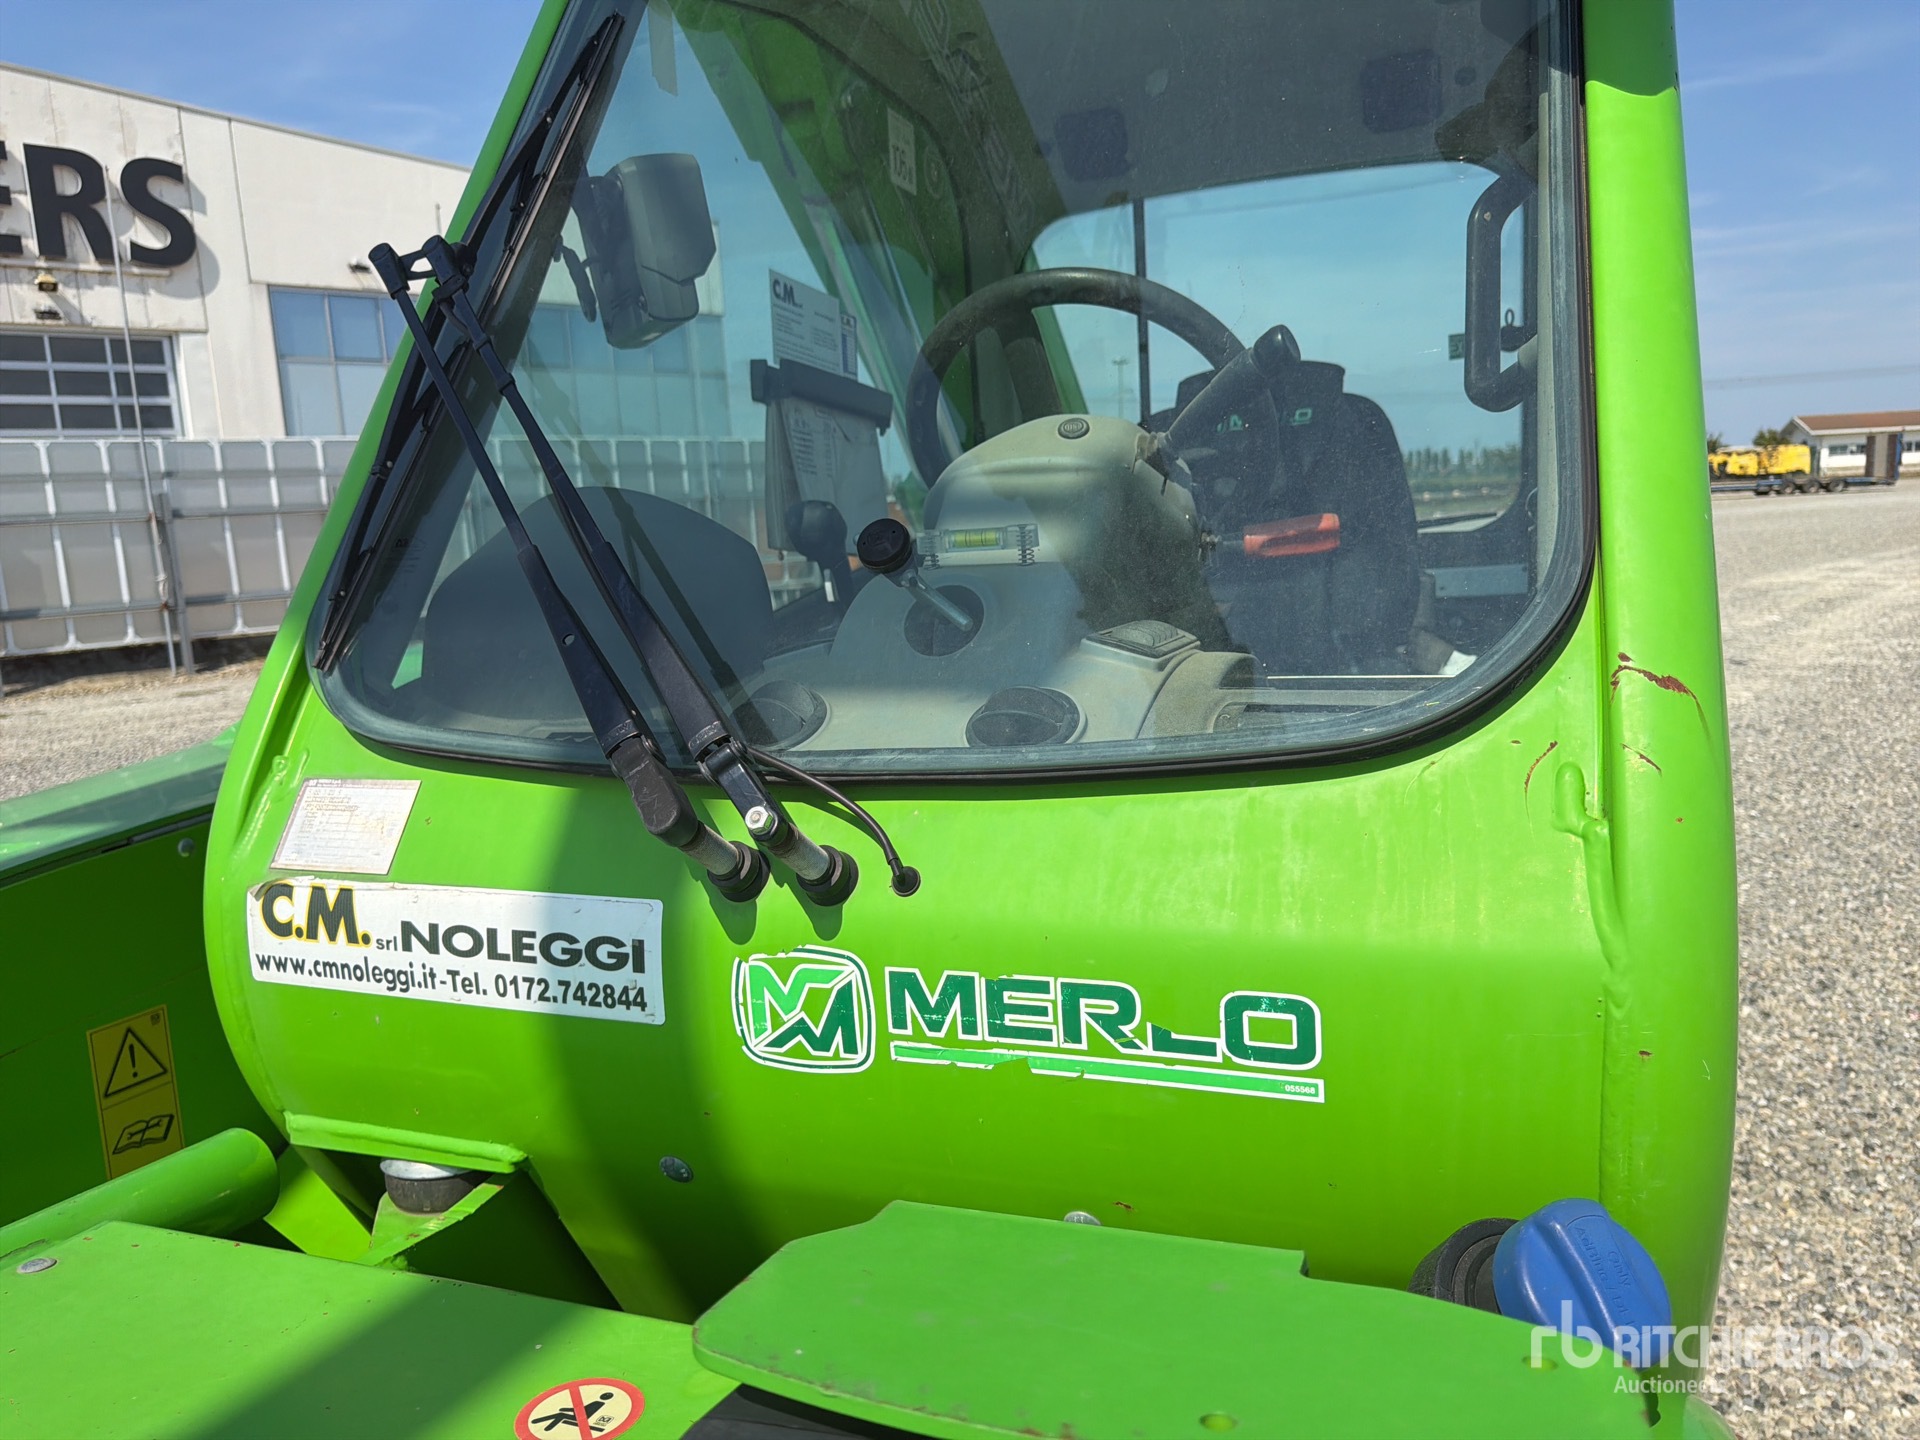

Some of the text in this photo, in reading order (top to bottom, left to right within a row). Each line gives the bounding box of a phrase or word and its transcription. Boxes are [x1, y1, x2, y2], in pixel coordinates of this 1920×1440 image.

[262, 880, 646, 974] C.M. srl NOLEGGI
[494, 973, 648, 1012] 0172.742844
[1284, 1084, 1316, 1095] 055568
